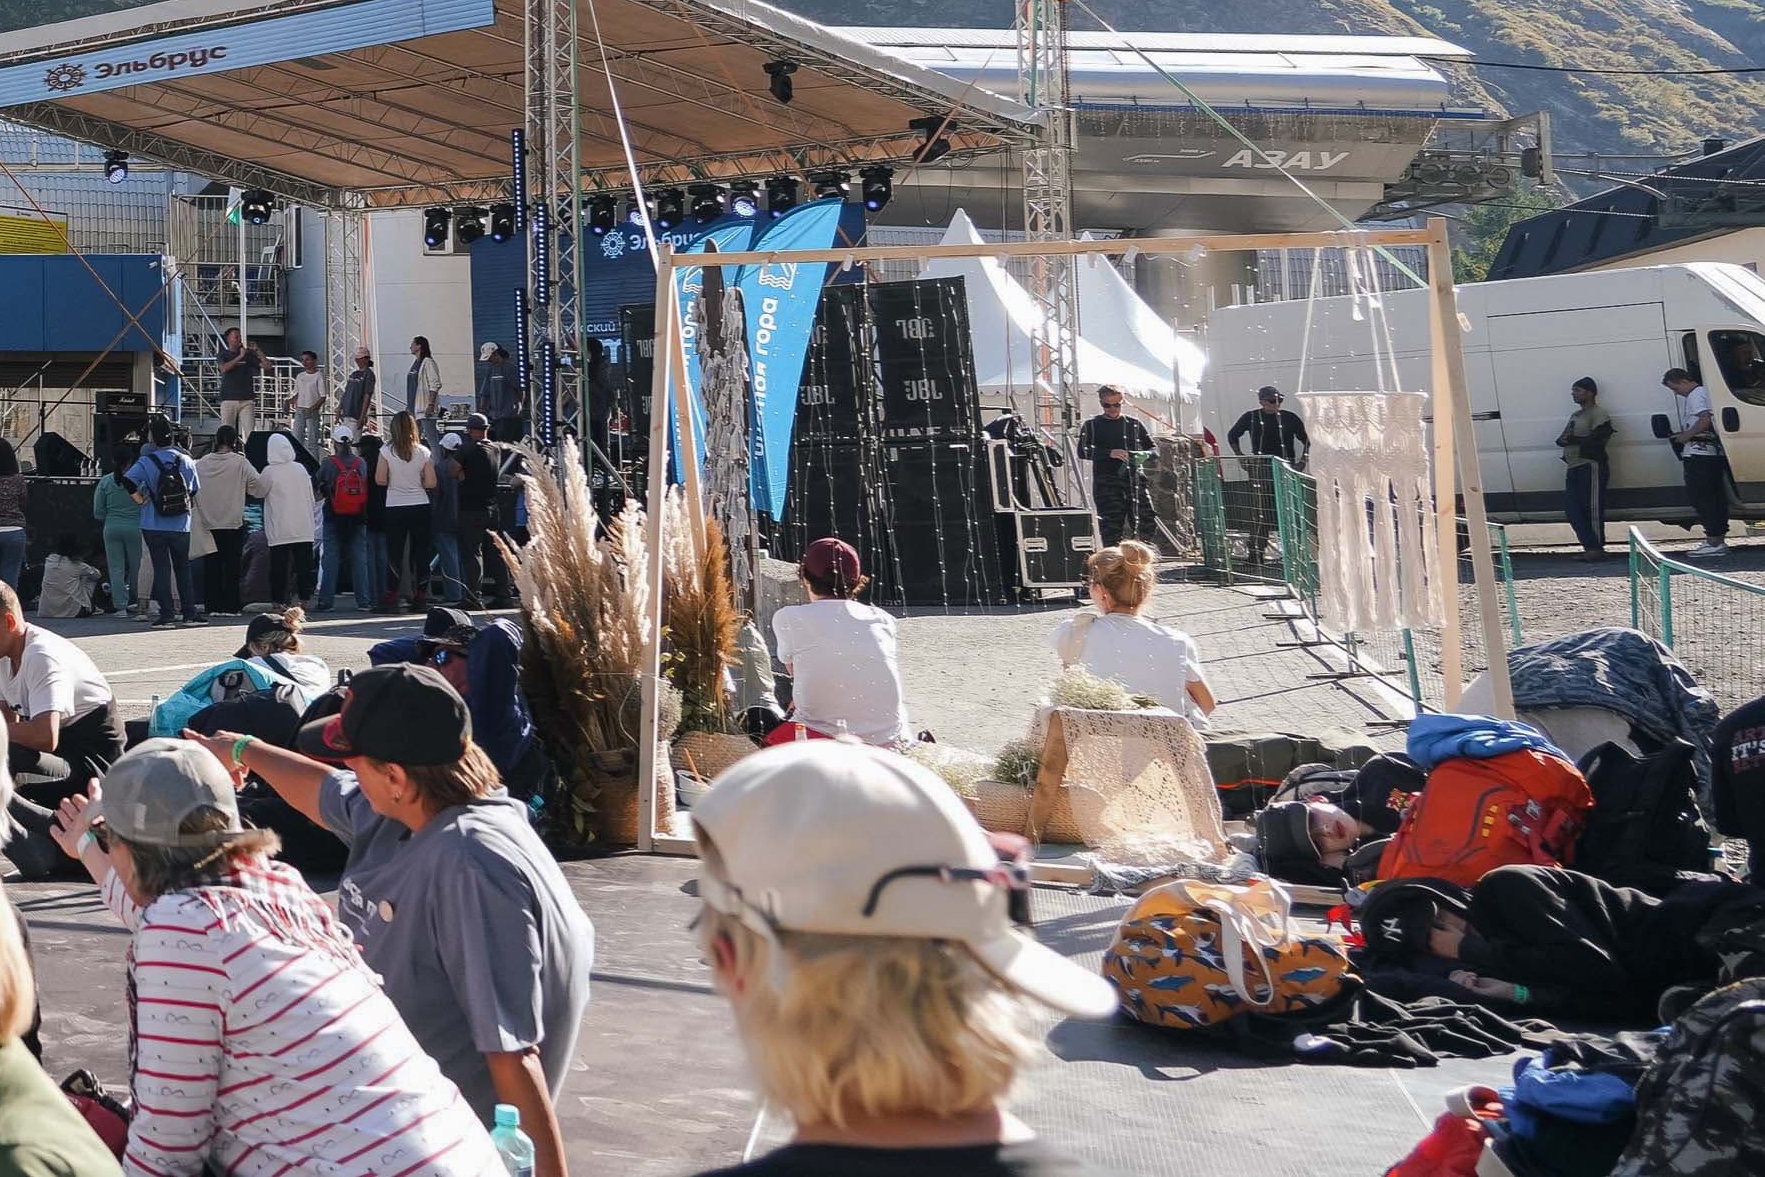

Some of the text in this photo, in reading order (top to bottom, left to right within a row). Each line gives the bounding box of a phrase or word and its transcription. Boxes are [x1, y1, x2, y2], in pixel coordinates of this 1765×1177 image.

[94, 45, 227, 79] Эльбрус
[1221, 149, 1350, 170] АЗАУ
[754, 296, 779, 356] гора
[896, 318, 935, 339] JBL
[799, 385, 835, 406] JBL
[903, 379, 943, 401] JBL
